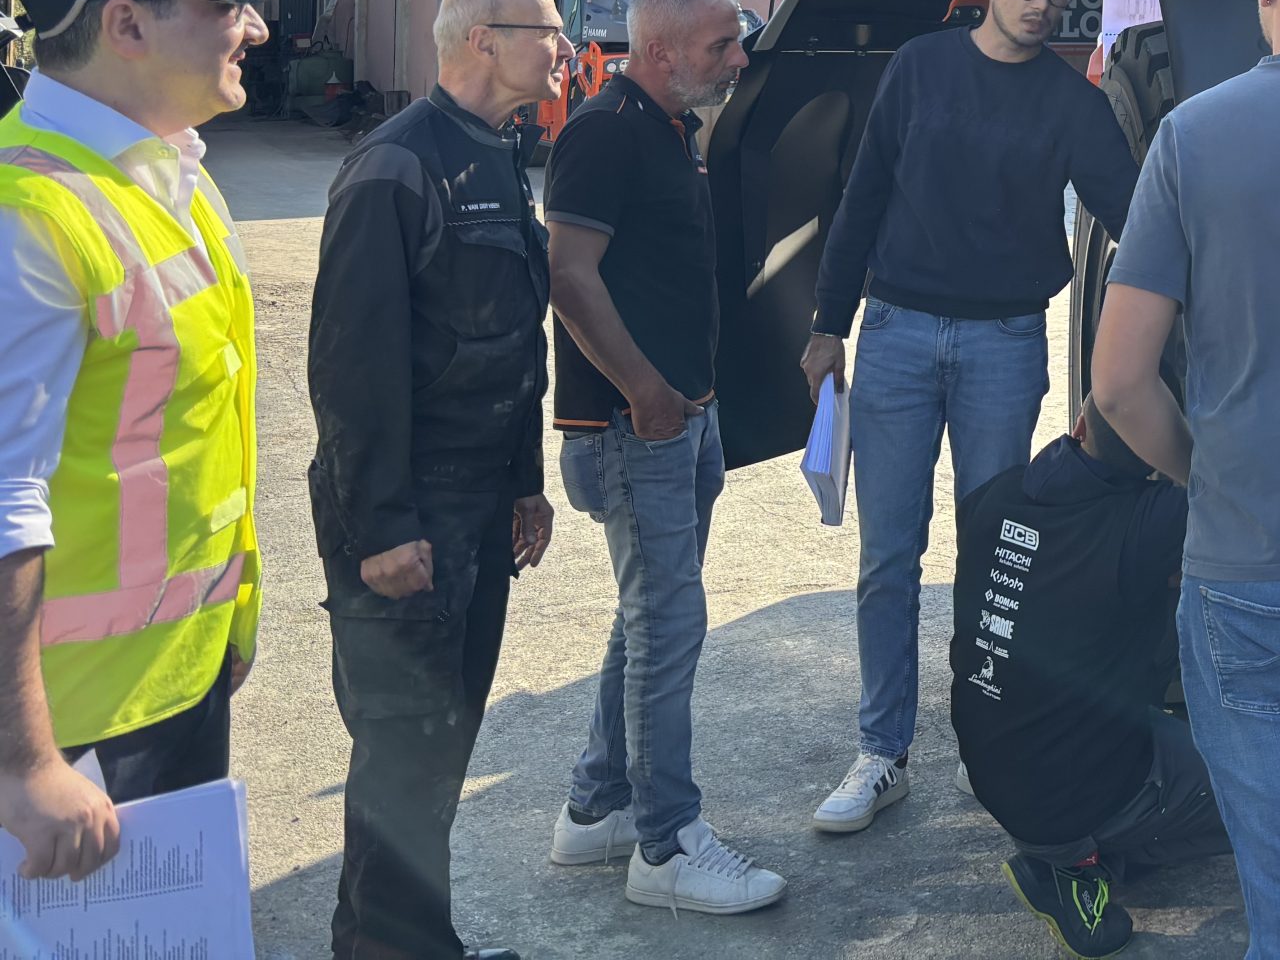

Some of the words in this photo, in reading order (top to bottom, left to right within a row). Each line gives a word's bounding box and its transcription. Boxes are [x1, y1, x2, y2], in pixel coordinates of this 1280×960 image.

[588, 27, 607, 38] HAMM
[1003, 522, 1037, 547] JCB
[994, 546, 1032, 567] HITACHI
[989, 568, 1024, 592] Kubota
[993, 593, 1020, 611] BOMAG
[989, 614, 1015, 640] SAME
[967, 673, 1002, 694] Lamborghini
